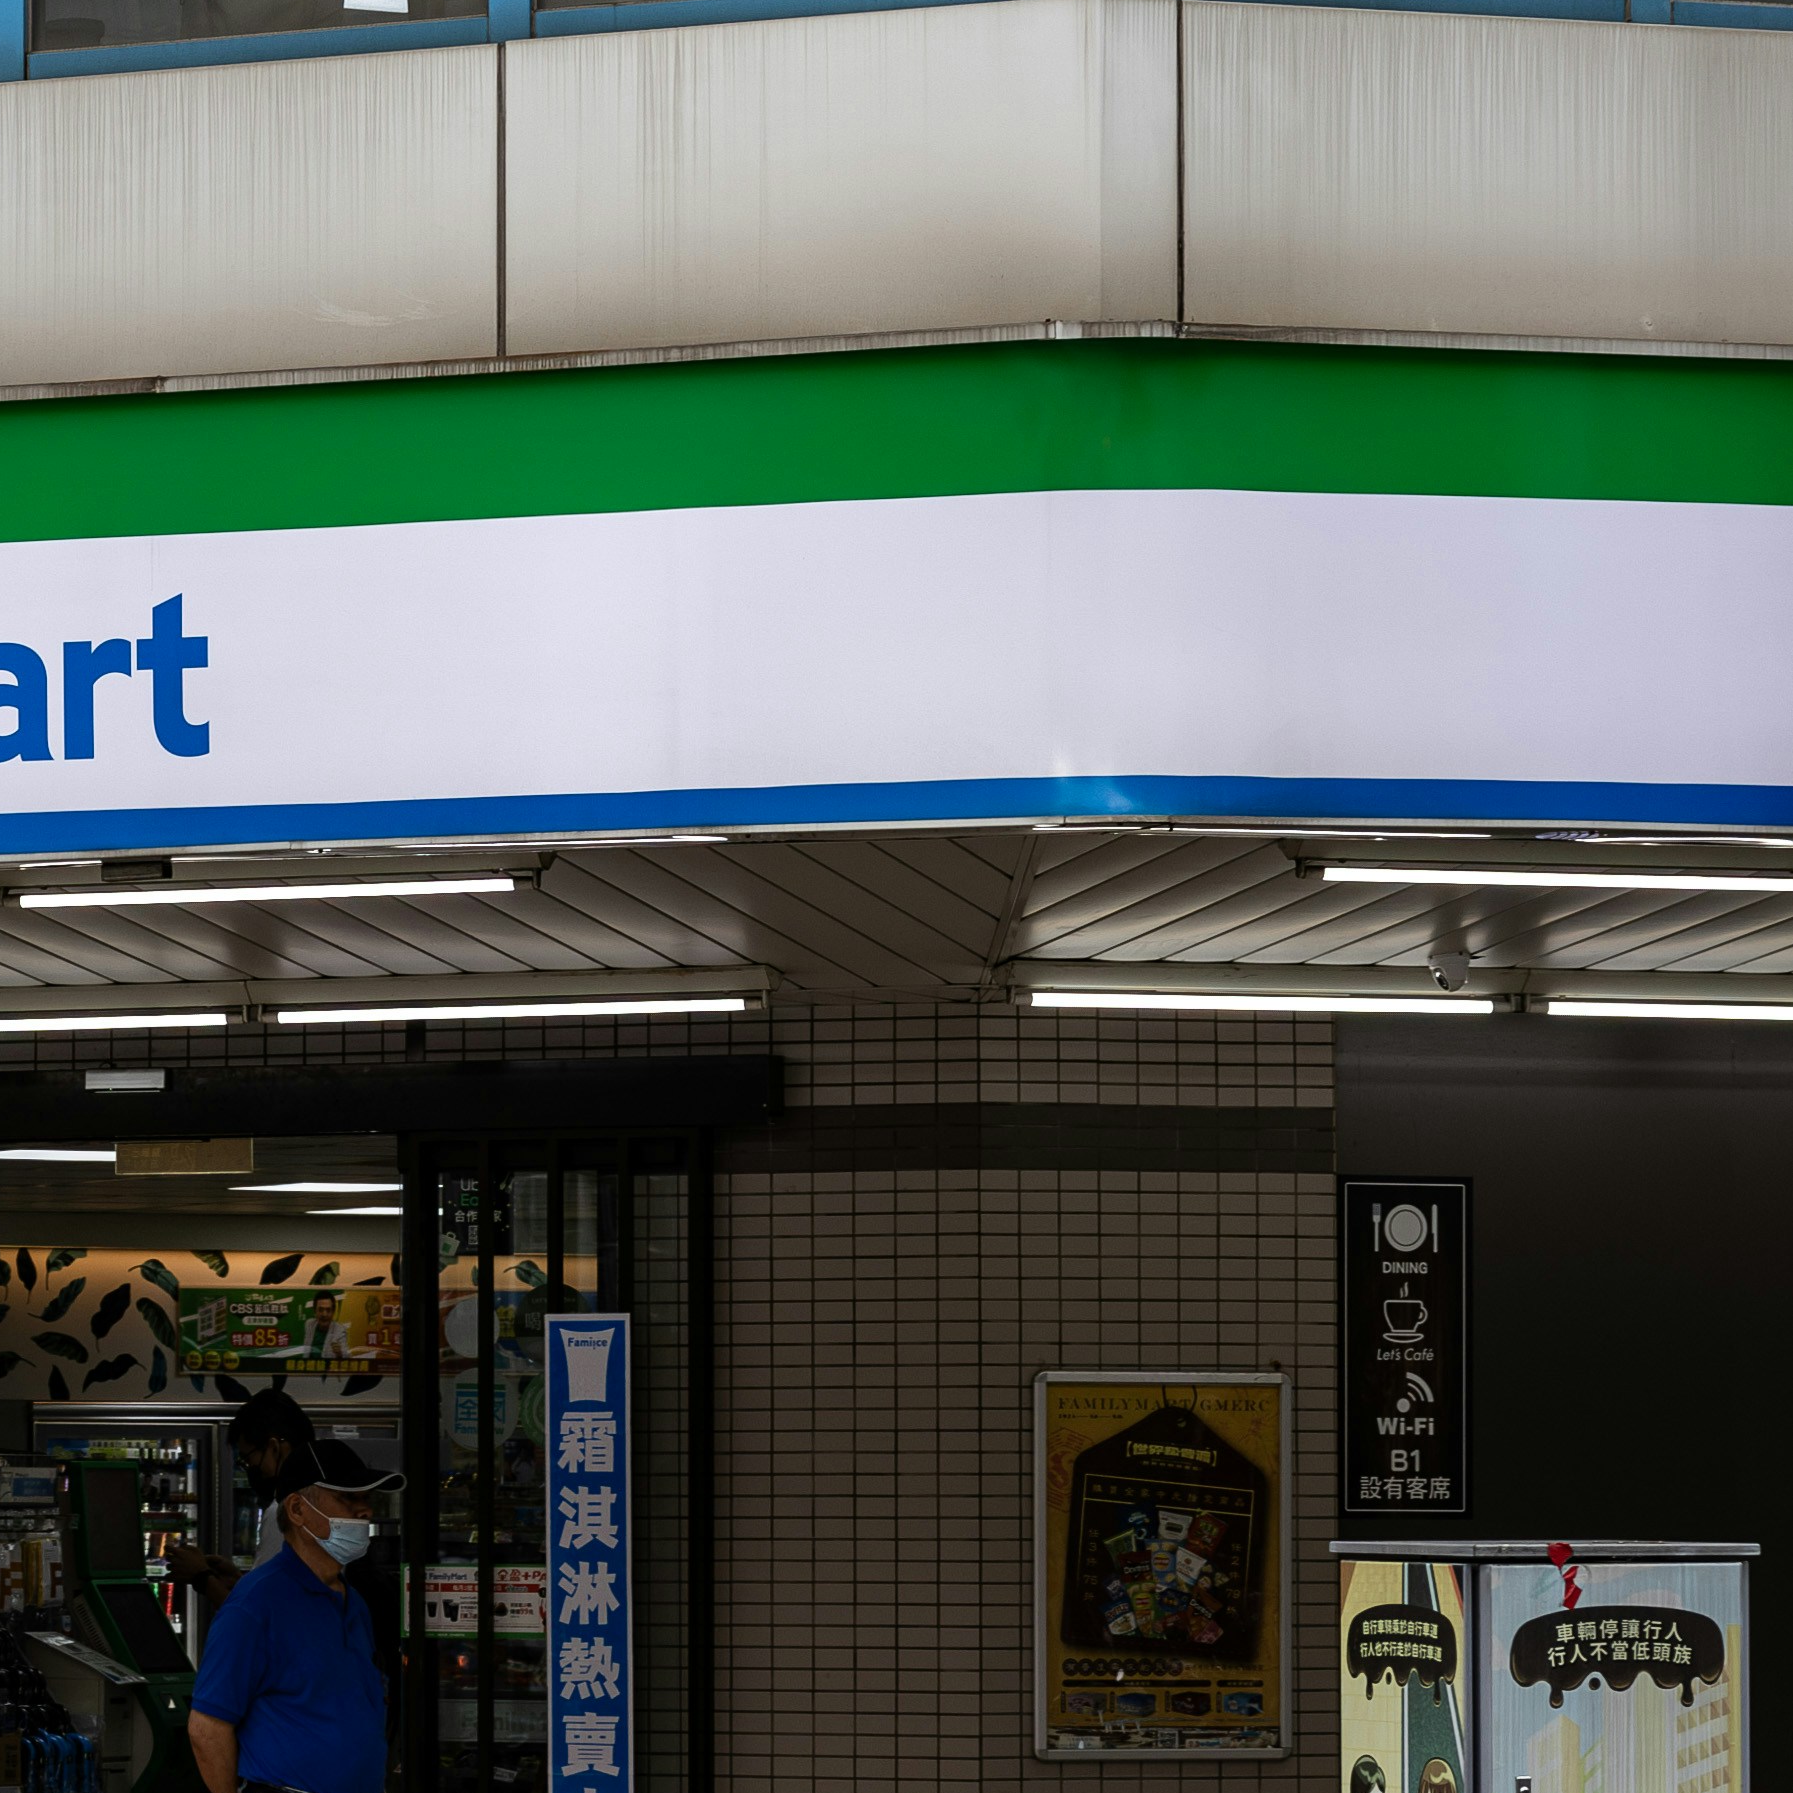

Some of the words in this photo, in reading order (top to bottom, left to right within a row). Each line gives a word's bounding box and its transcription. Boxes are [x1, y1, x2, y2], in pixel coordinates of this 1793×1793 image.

[1381, 1261, 1429, 1275] DINING
[1376, 1347, 1401, 1362] Let's
[1403, 1347, 1434, 1362] Café
[1376, 1417, 1435, 1436] Wi-Fi
[1390, 1449, 1421, 1473] B1
[1359, 1476, 1451, 1500] 設有客席
[1362, 1619, 1439, 1640] 自行車騎乘於自行車道
[1555, 1618, 1683, 1644] 車輛停讓行人
[1359, 1641, 1443, 1663] 行人也不行走於自行車道
[1547, 1640, 1693, 1667] 行人不當低頭族
